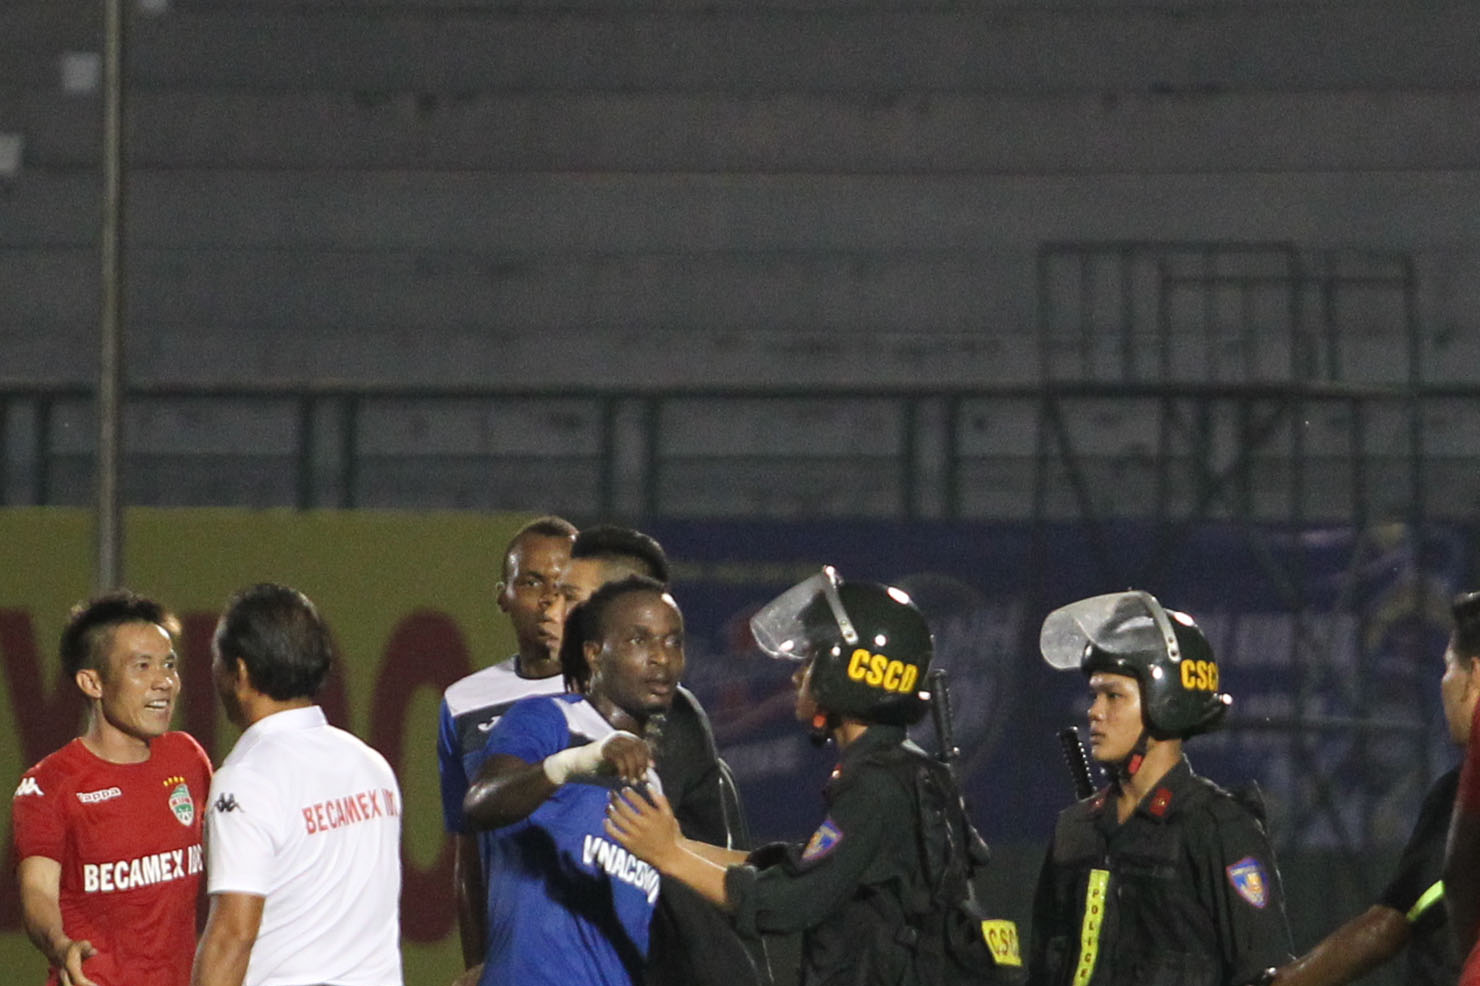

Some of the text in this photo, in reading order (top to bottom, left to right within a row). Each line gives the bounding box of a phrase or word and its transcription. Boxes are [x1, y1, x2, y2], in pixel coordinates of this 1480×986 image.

[1181, 658, 1219, 691] CSC
[302, 789, 382, 835] BECAMEX
[84, 849, 185, 892] BECAMEX
